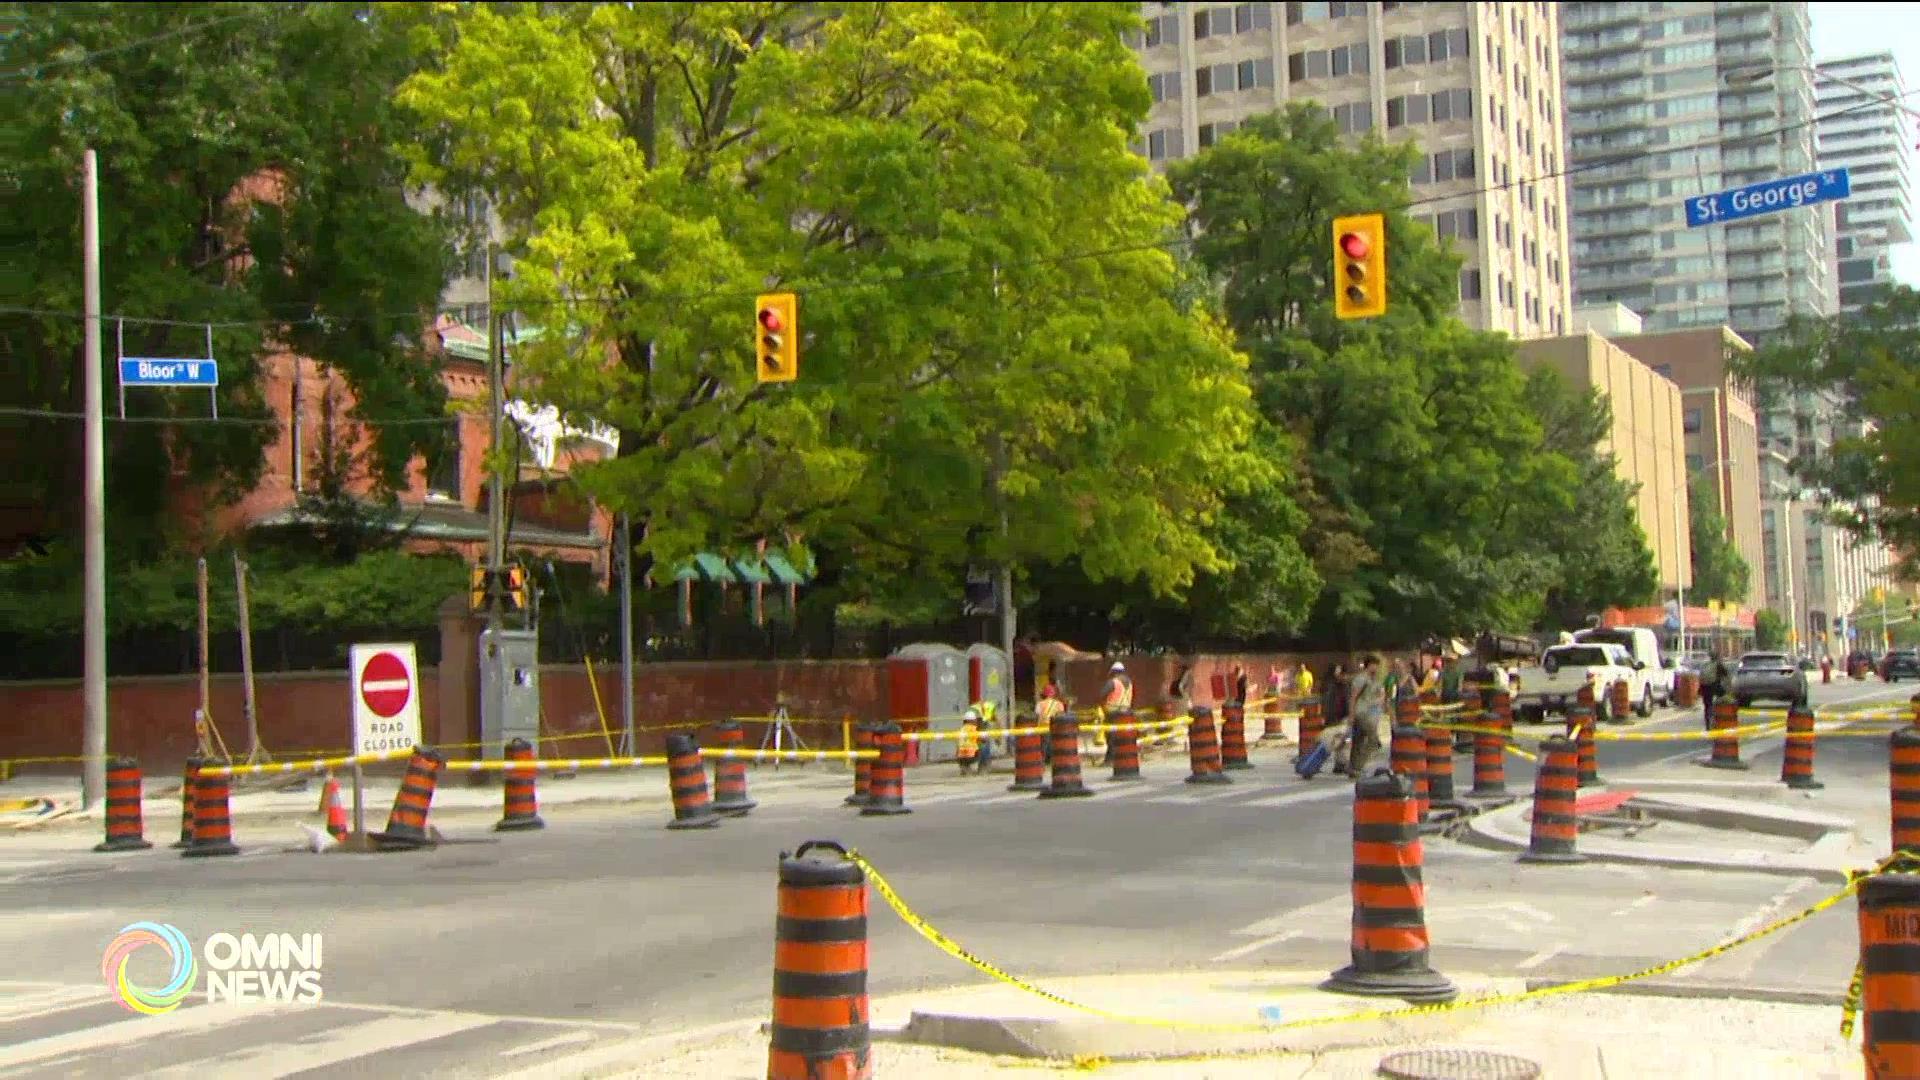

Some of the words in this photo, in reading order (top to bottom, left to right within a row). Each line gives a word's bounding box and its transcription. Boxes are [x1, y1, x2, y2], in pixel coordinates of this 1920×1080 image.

[1694, 197, 1726, 220] St.
[1732, 180, 1818, 213] George
[138, 361, 175, 379] Bloor
[187, 362, 200, 379] W
[371, 722, 404, 733] ROAD
[363, 737, 412, 752] CLOSED
